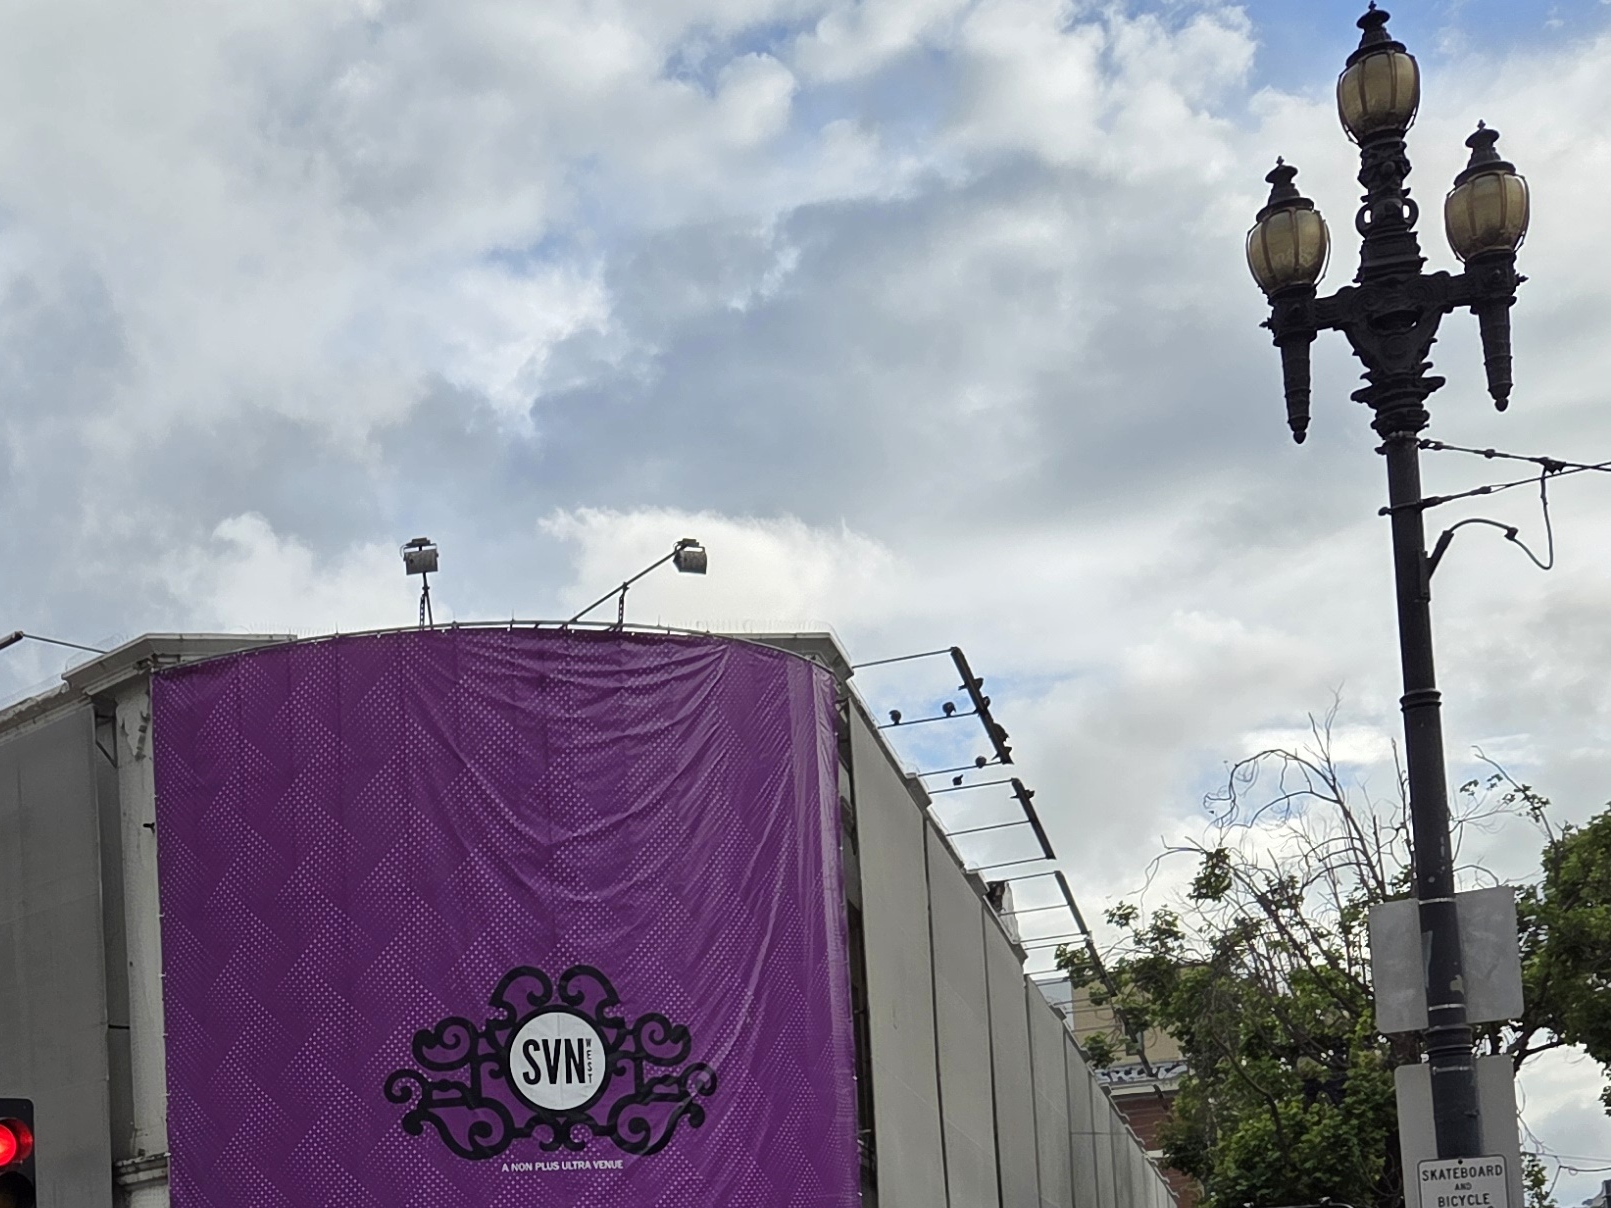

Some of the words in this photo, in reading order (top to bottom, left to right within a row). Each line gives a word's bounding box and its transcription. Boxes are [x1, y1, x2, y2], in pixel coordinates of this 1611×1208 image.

[522, 1037, 586, 1086] SVN
[585, 1037, 593, 1084] WEST
[501, 1162, 510, 1172] A
[511, 1161, 533, 1172] NON
[535, 1160, 560, 1171] PLUS
[561, 1159, 592, 1170] ULTRA
[592, 1159, 624, 1169] VENUE
[1421, 1164, 1503, 1181] SKATEBOARD
[1454, 1182, 1472, 1191] AND
[1437, 1192, 1490, 1208] BICYCLE
